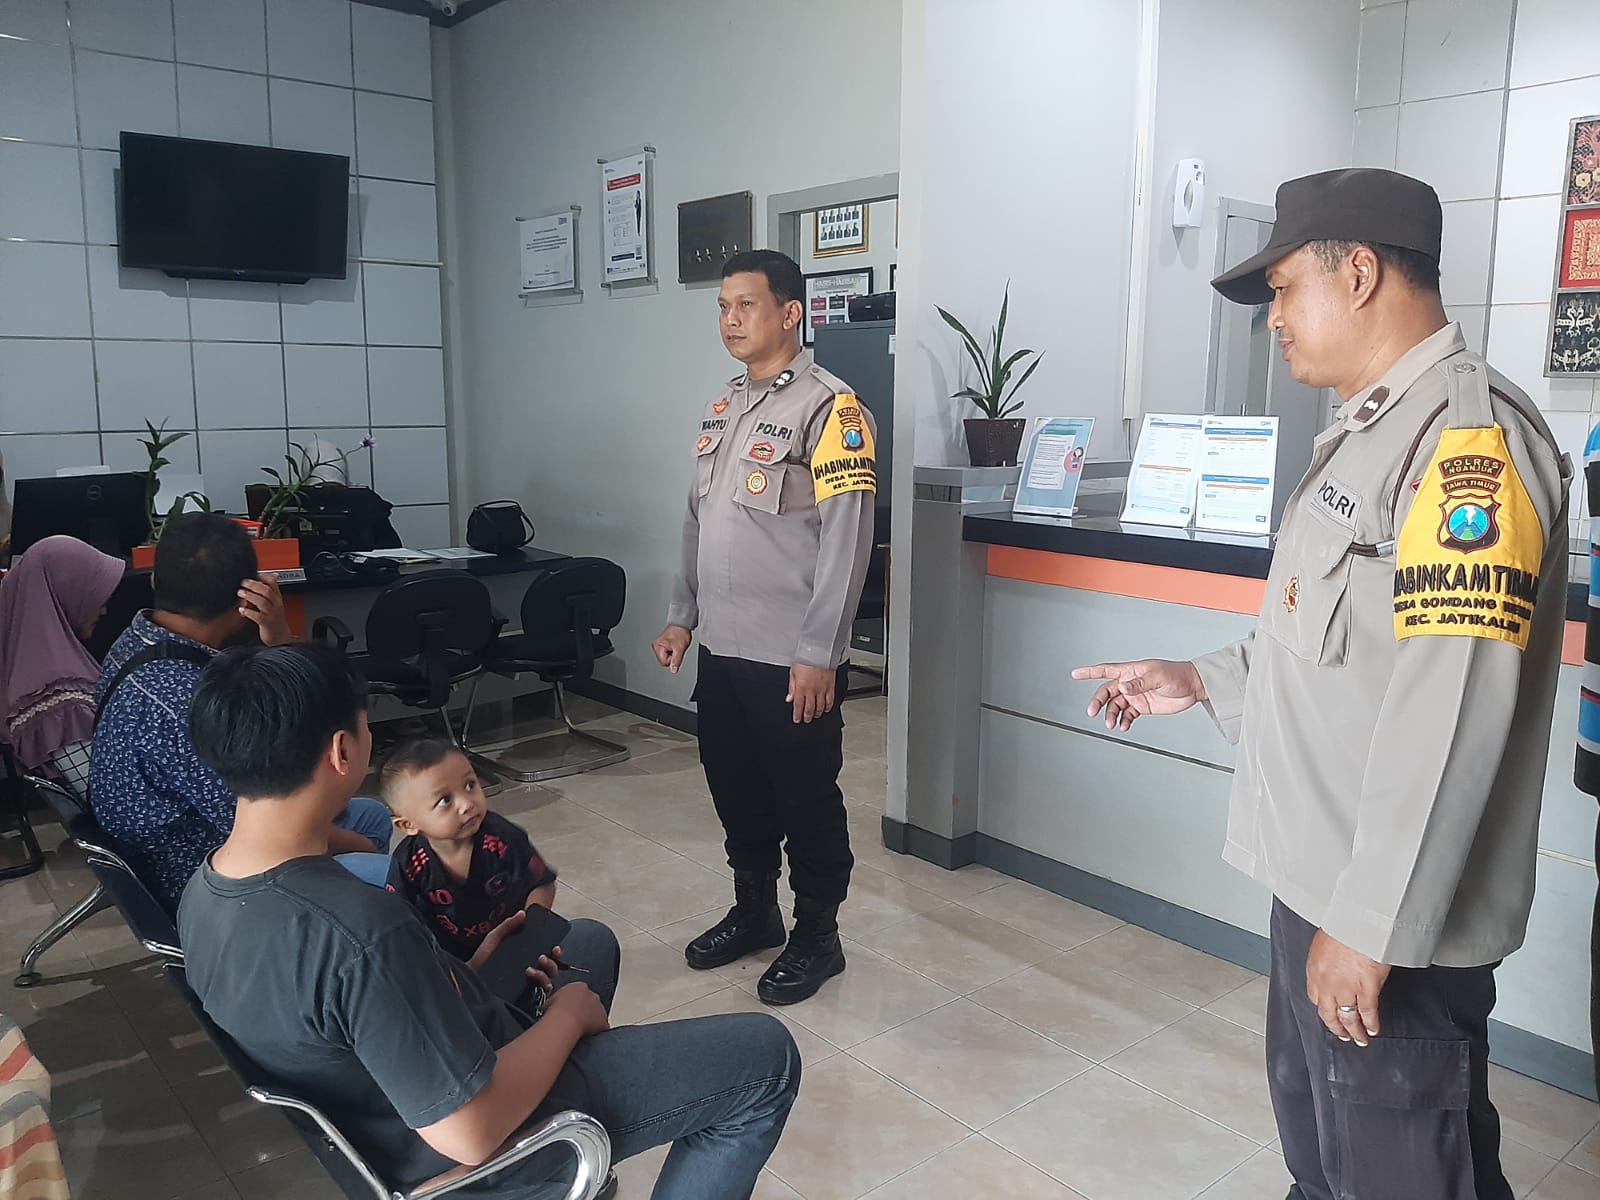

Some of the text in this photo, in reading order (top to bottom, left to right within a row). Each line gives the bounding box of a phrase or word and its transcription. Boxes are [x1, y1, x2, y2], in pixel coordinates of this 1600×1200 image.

[756, 422, 793, 440] POLRI
[1443, 458, 1499, 470] POLRES
[1446, 480, 1496, 490] JAWA TIMUR
[1318, 480, 1356, 518] POLRI
[1420, 597, 1498, 610] GONDANG
